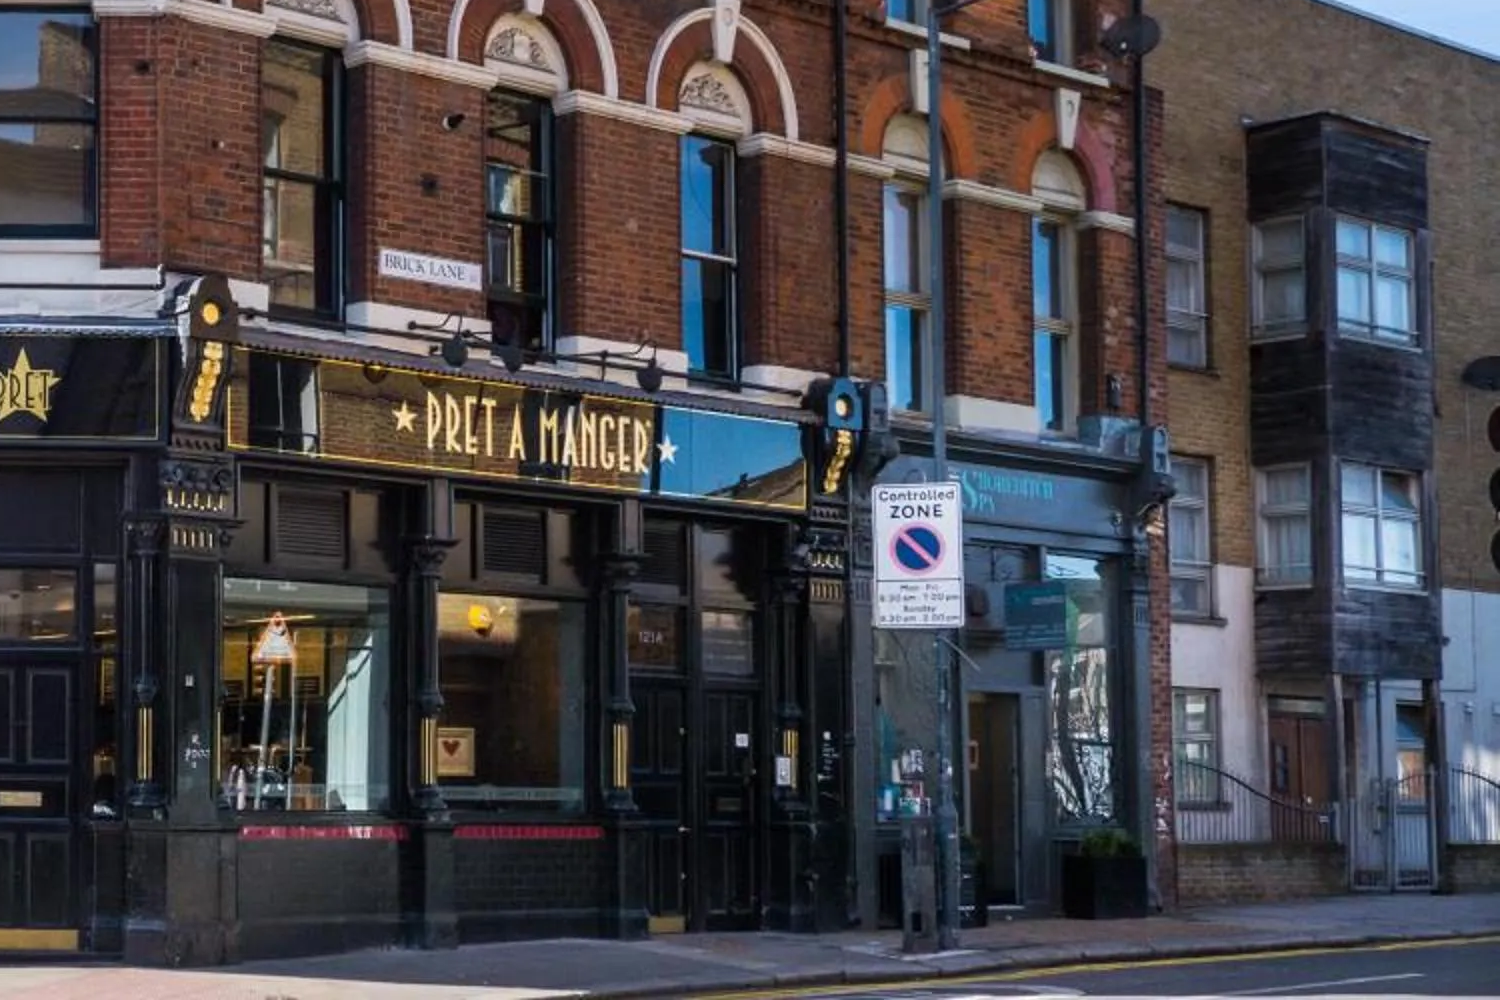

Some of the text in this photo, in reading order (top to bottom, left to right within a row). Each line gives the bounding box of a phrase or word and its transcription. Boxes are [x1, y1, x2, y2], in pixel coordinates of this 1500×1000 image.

[384, 253, 425, 274] BRICK
[429, 261, 464, 281] LANE
[426, 390, 649, 474] PRET A MANGER
[879, 487, 955, 501] Controlled
[889, 504, 943, 519] ZONE
